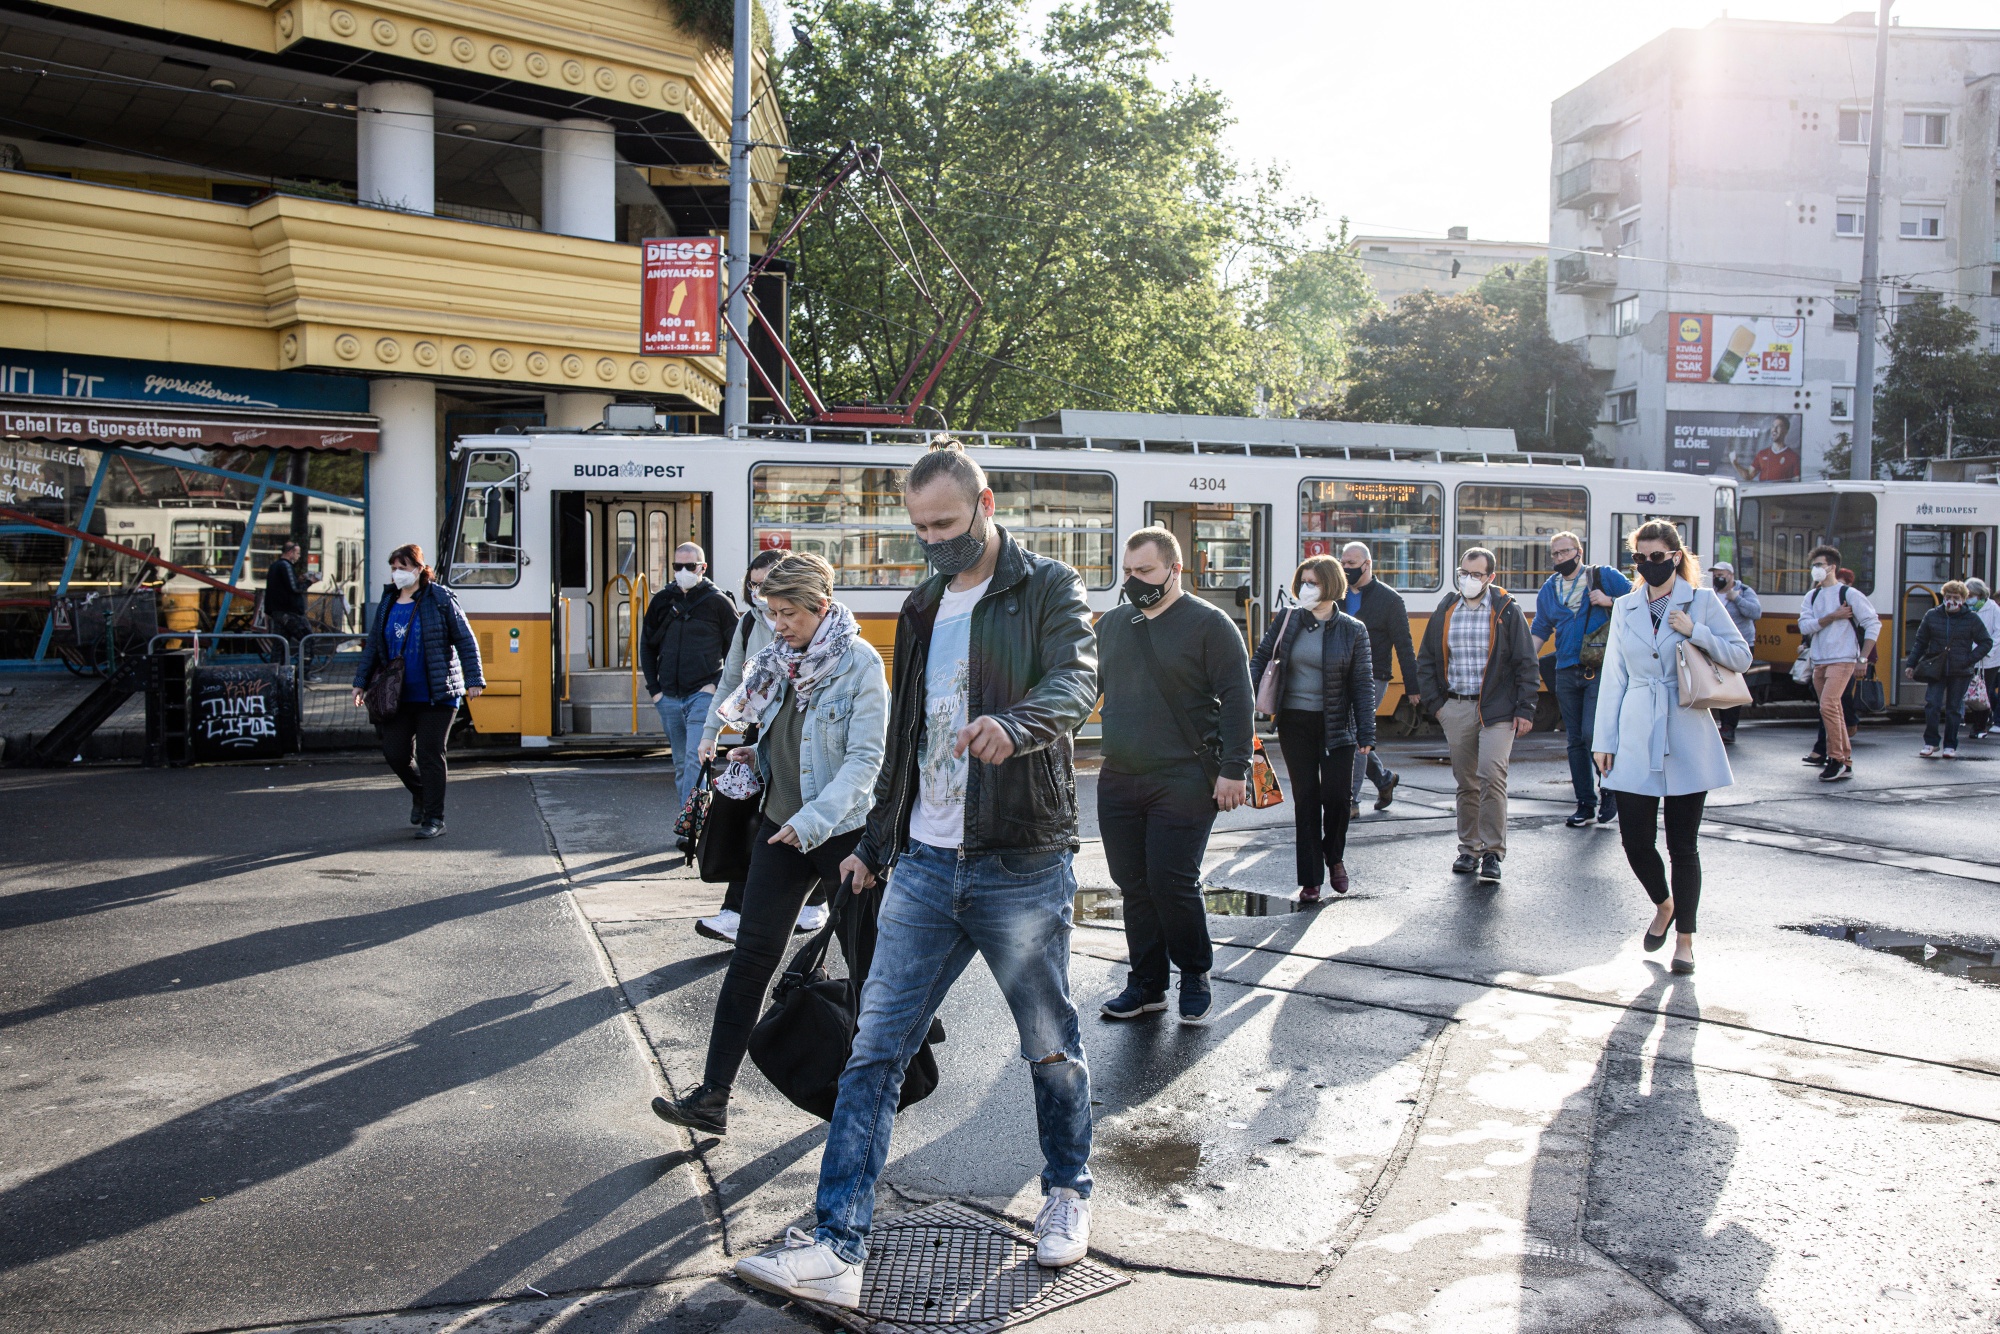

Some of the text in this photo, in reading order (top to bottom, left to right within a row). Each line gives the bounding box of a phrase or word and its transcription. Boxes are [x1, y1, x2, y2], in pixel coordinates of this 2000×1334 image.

[647, 267, 714, 279] ANGYALFÖLD
[660, 318, 696, 327] 400 m
[645, 331, 713, 342] Lehel u. 12.
[1676, 361, 1703, 372] CSAK
[144, 375, 278, 407] gyorsétterem
[5, 415, 51, 433] Lehel
[88, 419, 202, 439] Gyorsétterem
[1674, 425, 1760, 438] EGY EMBERKÉNT
[1674, 437, 1710, 449] ELŐRE.
[3, 474, 65, 500] SALÁTÁK
[1189, 477, 1226, 491] 4304
[1318, 481, 1335, 500] 14
[1935, 506, 1978, 514] BUDAPEST
[1756, 634, 1781, 646] 4149
[201, 695, 267, 717] TUNA
